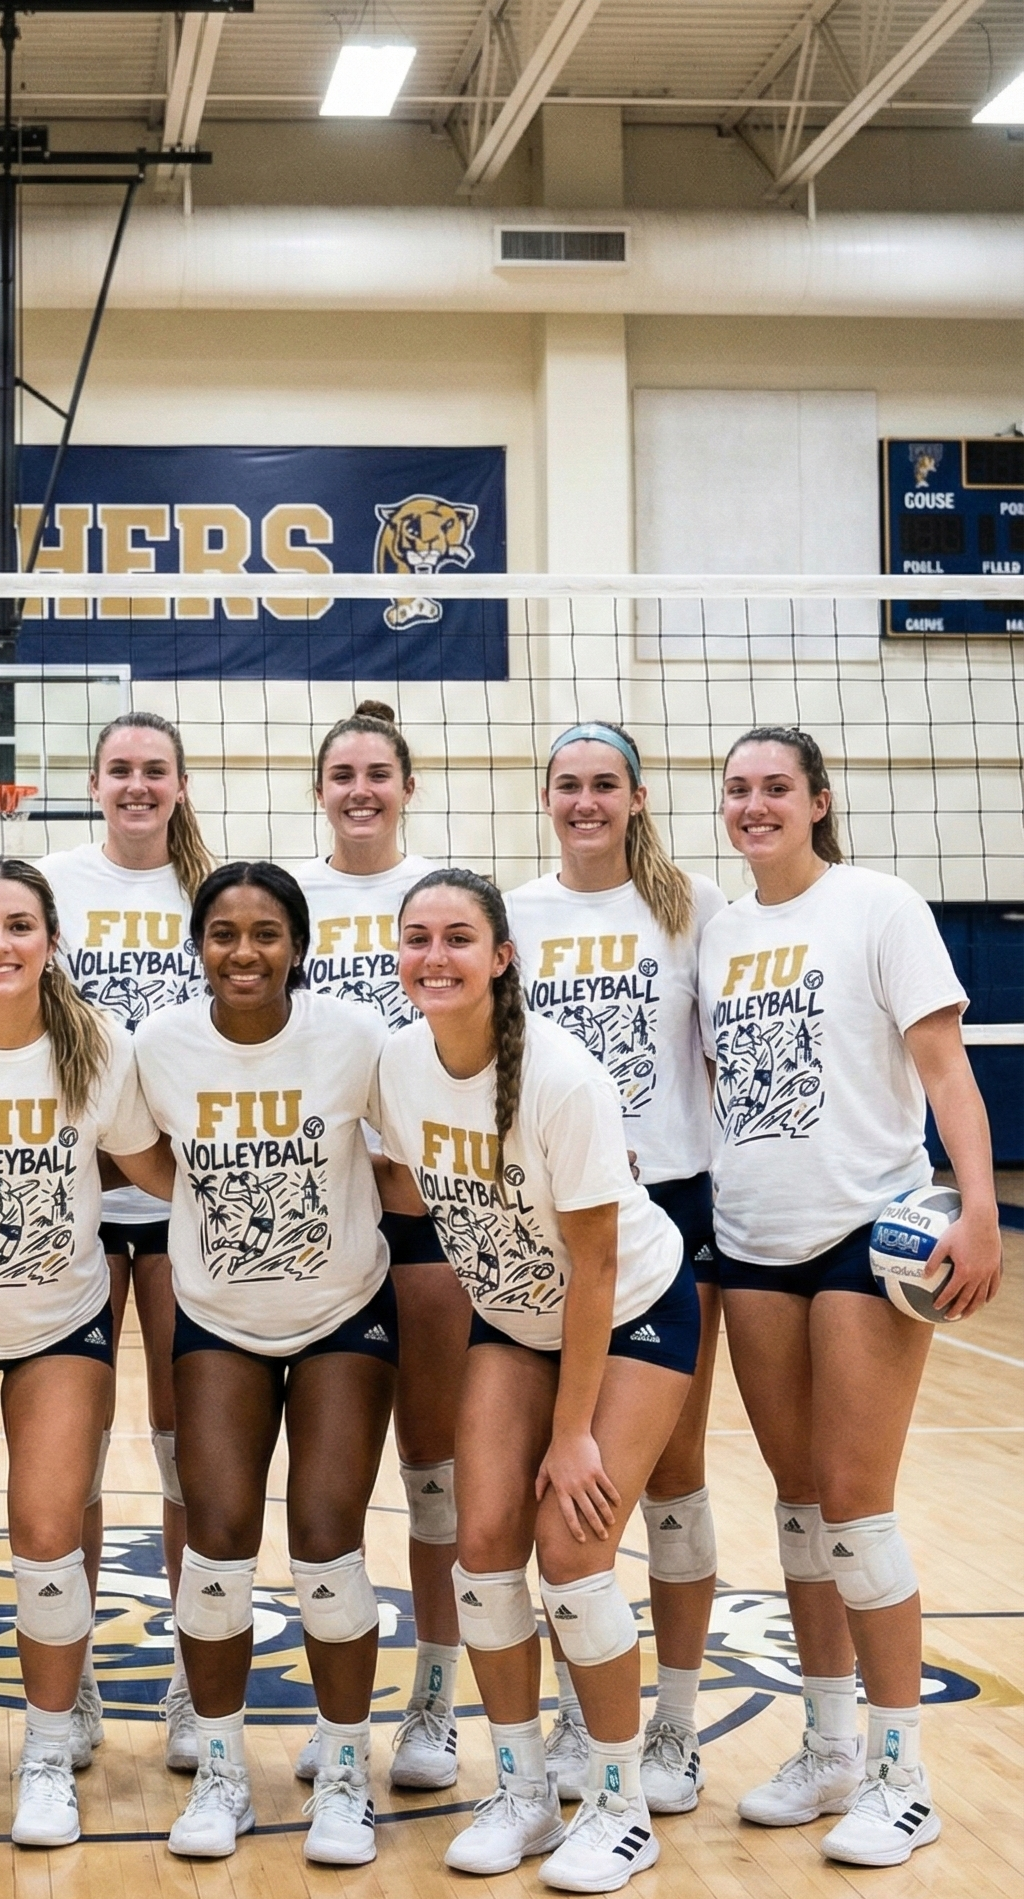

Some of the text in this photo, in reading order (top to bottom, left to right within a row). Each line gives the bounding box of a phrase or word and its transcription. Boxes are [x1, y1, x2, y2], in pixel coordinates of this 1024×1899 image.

[85, 910, 182, 949] FIU
[67, 948, 202, 982] VOLLEYBALL
[539, 934, 638, 978] FIU
[722, 944, 809, 997] FIU
[523, 974, 660, 1012] VOLLEYBALL
[196, 1089, 302, 1138] FIU
[182, 1137, 328, 1171] VOLLEYBALL
[422, 1120, 499, 1181] FIU
